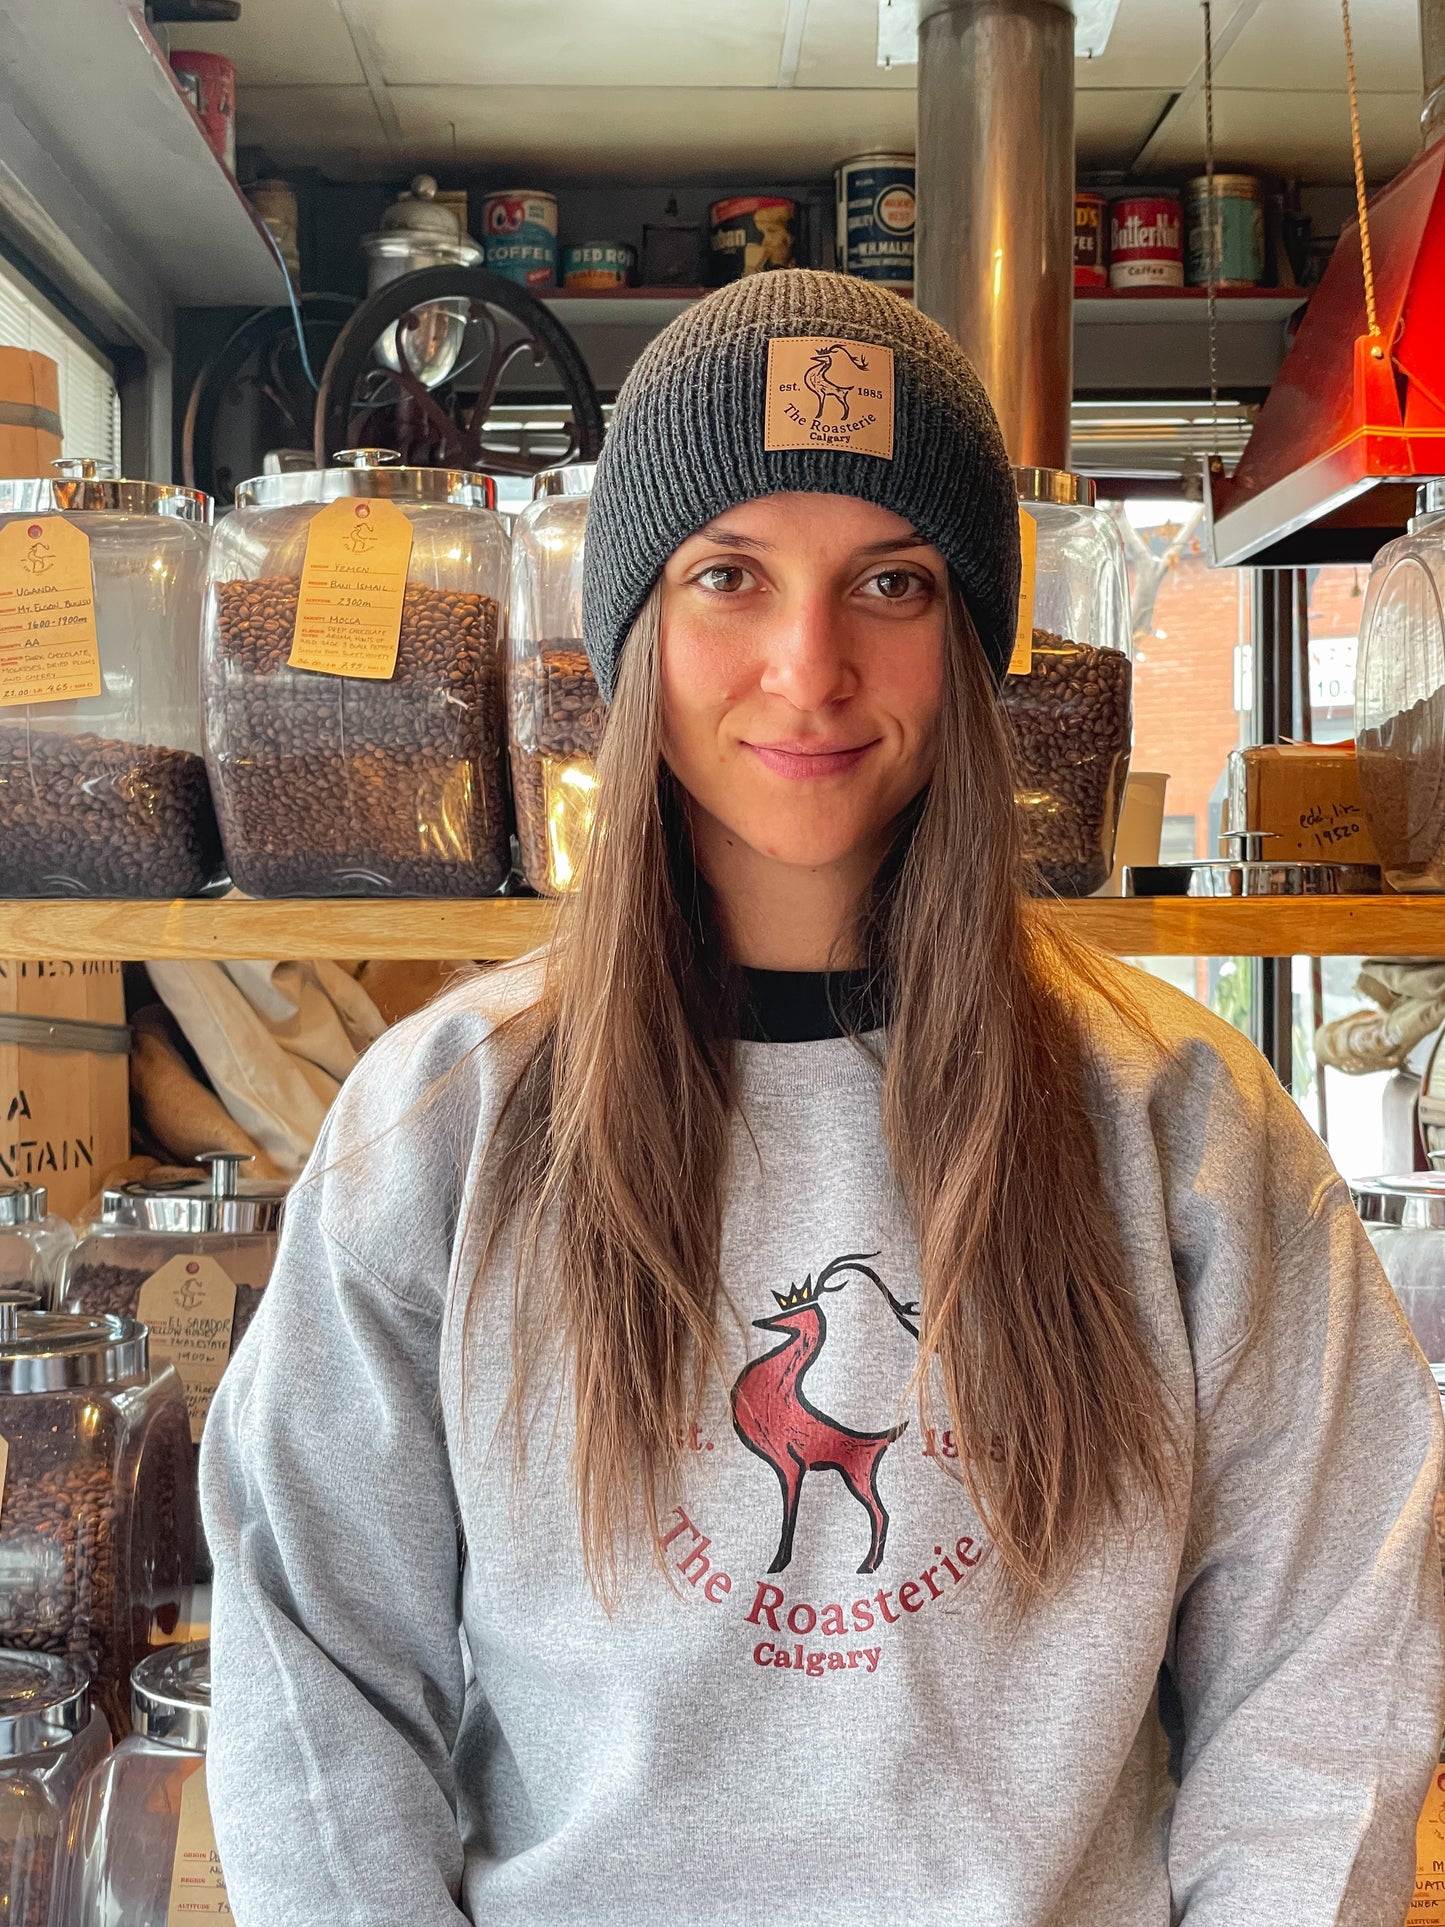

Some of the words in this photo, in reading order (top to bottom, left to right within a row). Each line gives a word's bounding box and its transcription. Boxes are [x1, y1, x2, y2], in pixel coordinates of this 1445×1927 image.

[1075, 207, 1099, 227] D'S
[486, 246, 553, 262] COFFEE
[572, 248, 603, 262] RED
[1128, 266, 1164, 276] Coffee
[779, 382, 801, 392] est.
[857, 387, 883, 399] 1985
[783, 402, 807, 426] The
[810, 412, 877, 434] Roasterie
[809, 431, 851, 444] Calgary
[335, 564, 369, 574] YEMEN
[16, 585, 58, 597] UGANDA
[330, 580, 351, 590] BANI
[357, 581, 388, 592] ISMAIL
[337, 597, 371, 608] 2300m
[329, 615, 361, 625] MOCCA
[24, 638, 40, 648] AA
[1315, 823, 1360, 847] 19520
[168, 1315, 181, 1328] EL
[657, 1505, 732, 1603] The
[743, 1536, 983, 1636] Roasterie
[753, 1642, 882, 1677] Calgary
